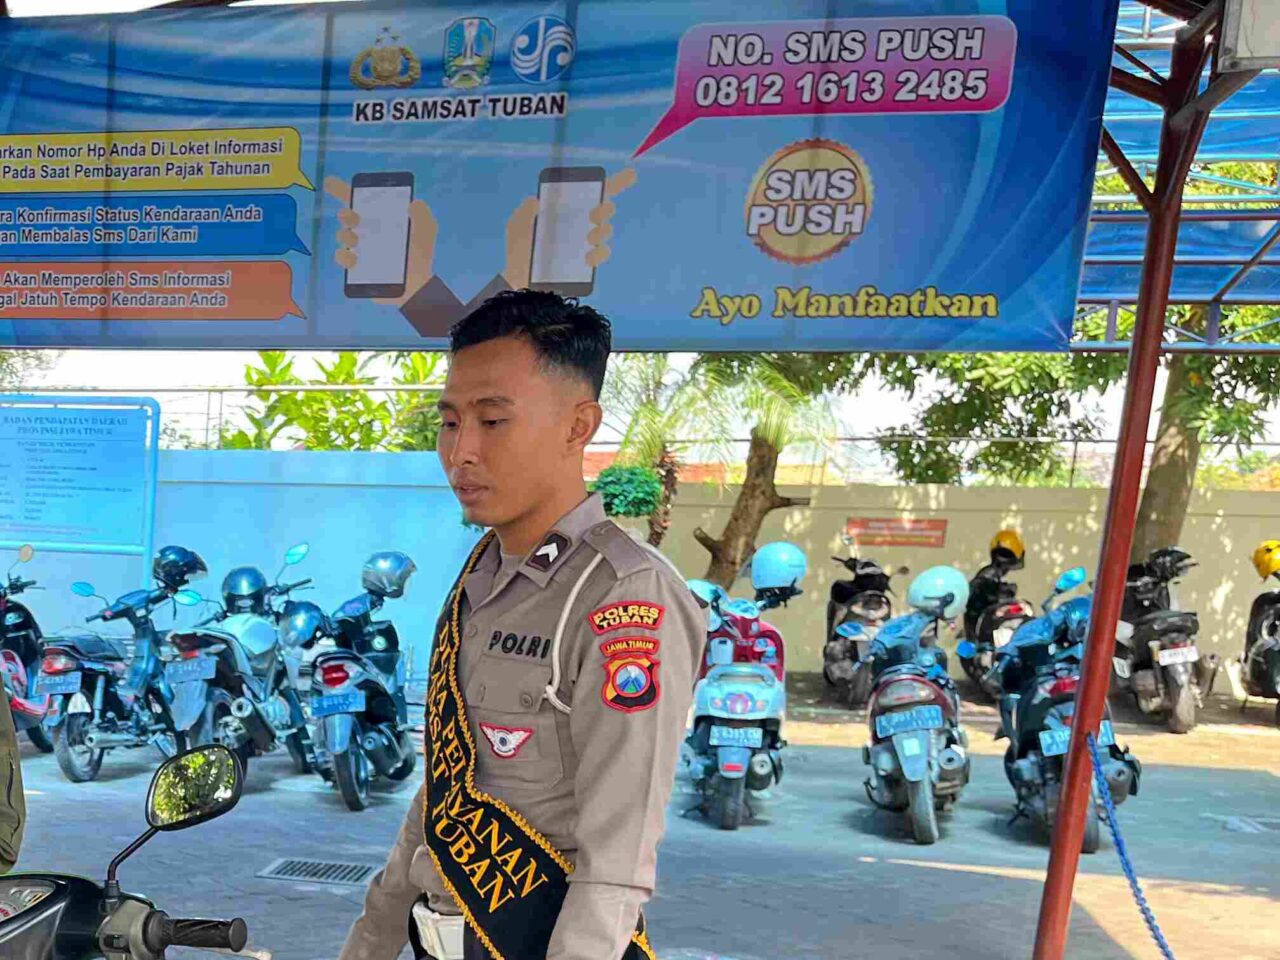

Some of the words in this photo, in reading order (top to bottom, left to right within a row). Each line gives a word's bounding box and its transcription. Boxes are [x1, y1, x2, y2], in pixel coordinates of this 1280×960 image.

[708, 34, 773, 66] NO.
[784, 31, 866, 63] SMS
[876, 28, 984, 61] PUSH
[695, 73, 784, 106] 0812
[796, 71, 885, 104] 1613
[894, 69, 988, 101] 2485
[355, 102, 384, 121] KB
[391, 98, 482, 120] SAMSAT
[488, 94, 566, 117] TUBAN
[36, 144, 83, 158] Nomor
[87, 143, 106, 161] Hp
[110, 142, 146, 157] Anda
[151, 141, 166, 156] Di
[170, 141, 210, 155] Loket
[214, 138, 283, 154] Informasi
[2, 165, 36, 179] Pada
[40, 164, 70, 179] Saat
[74, 163, 161, 181] Pembayaran
[165, 162, 204, 180] Pajak
[209, 161, 270, 176] Tahunan
[764, 168, 857, 201] SMS
[17, 207, 91, 223] Konfirmasi
[95, 207, 139, 222] Status
[143, 206, 220, 221] Kendaraan
[224, 205, 262, 220] Anda
[746, 203, 866, 236] PUSH
[21, 227, 89, 243] Membalas
[94, 228, 124, 242] Sms
[128, 227, 156, 242] Dari
[161, 226, 198, 242] Kami
[3, 272, 37, 286] Akan
[41, 271, 124, 290] Memperoleh
[129, 272, 159, 286] Sms
[163, 271, 231, 286] Informasi
[20, 292, 58, 306] Jatuh
[62, 292, 107, 309] Tempo
[111, 292, 186, 307] Kendaraan
[189, 292, 227, 306] Anda
[691, 287, 761, 325] Ayo
[773, 286, 999, 319] Manfaatkan
[593, 605, 660, 626] POLRES
[599, 615, 655, 628] TUBAN
[488, 630, 551, 659] POLRI
[606, 641, 629, 653] JAWA
[628, 640, 655, 650] TIMUR
[431, 791, 516, 914] TUBAN
